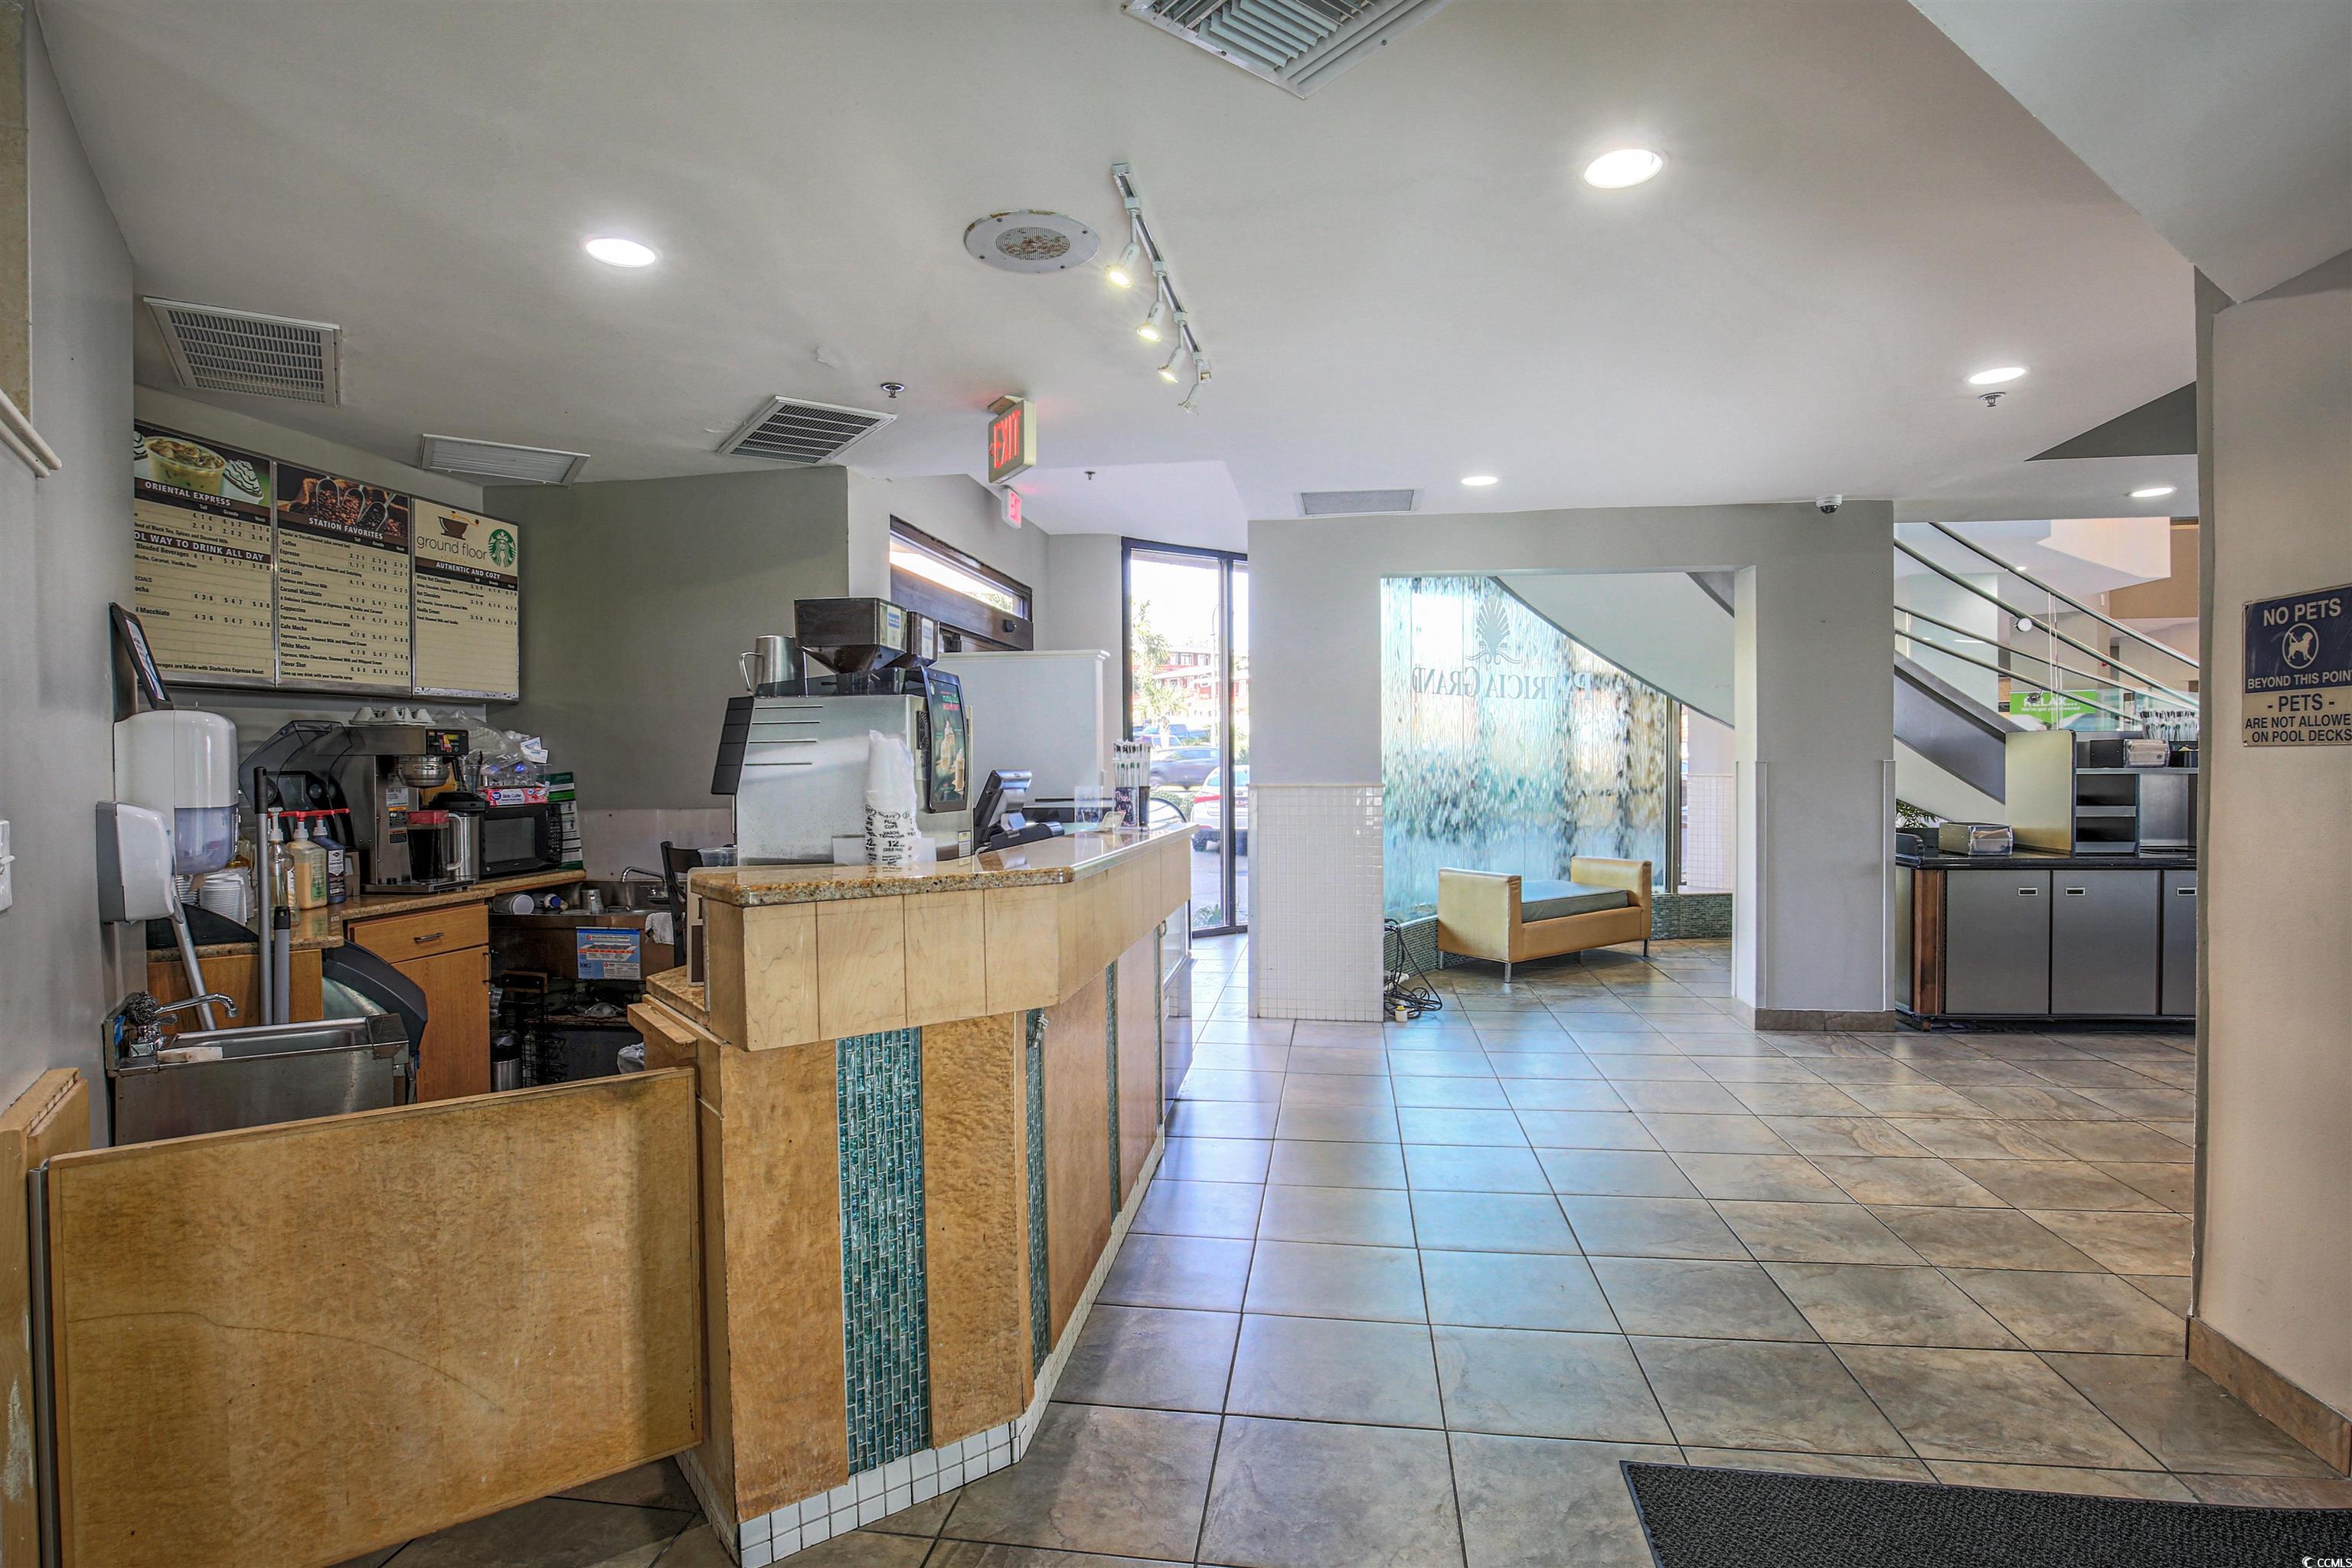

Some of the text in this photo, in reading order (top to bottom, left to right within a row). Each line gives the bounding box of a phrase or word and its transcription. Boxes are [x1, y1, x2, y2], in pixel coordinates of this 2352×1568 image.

[995, 410, 1021, 469] EXIT
[145, 481, 230, 506] ORIENTAL EXPRESS
[309, 517, 383, 540] STATION FAVORITES
[134, 531, 263, 560] OL WAY TO DRINK ALL DAY
[136, 543, 188, 558] Blended Beverages
[416, 535, 487, 560] ground floor
[436, 561, 469, 573] AUTHENTIC
[139, 607, 169, 616] Macchiato
[280, 605, 305, 613] Cappuccino
[2263, 598, 2341, 626] NO PETS
[2248, 675, 2291, 689] BEYOND
[2293, 672, 2319, 685] THIS
[2278, 693, 2323, 712] PETS
[2245, 714, 2351, 729] ARE NOT ALLOWE
[2252, 728, 2352, 743] ON POOL DECKS
